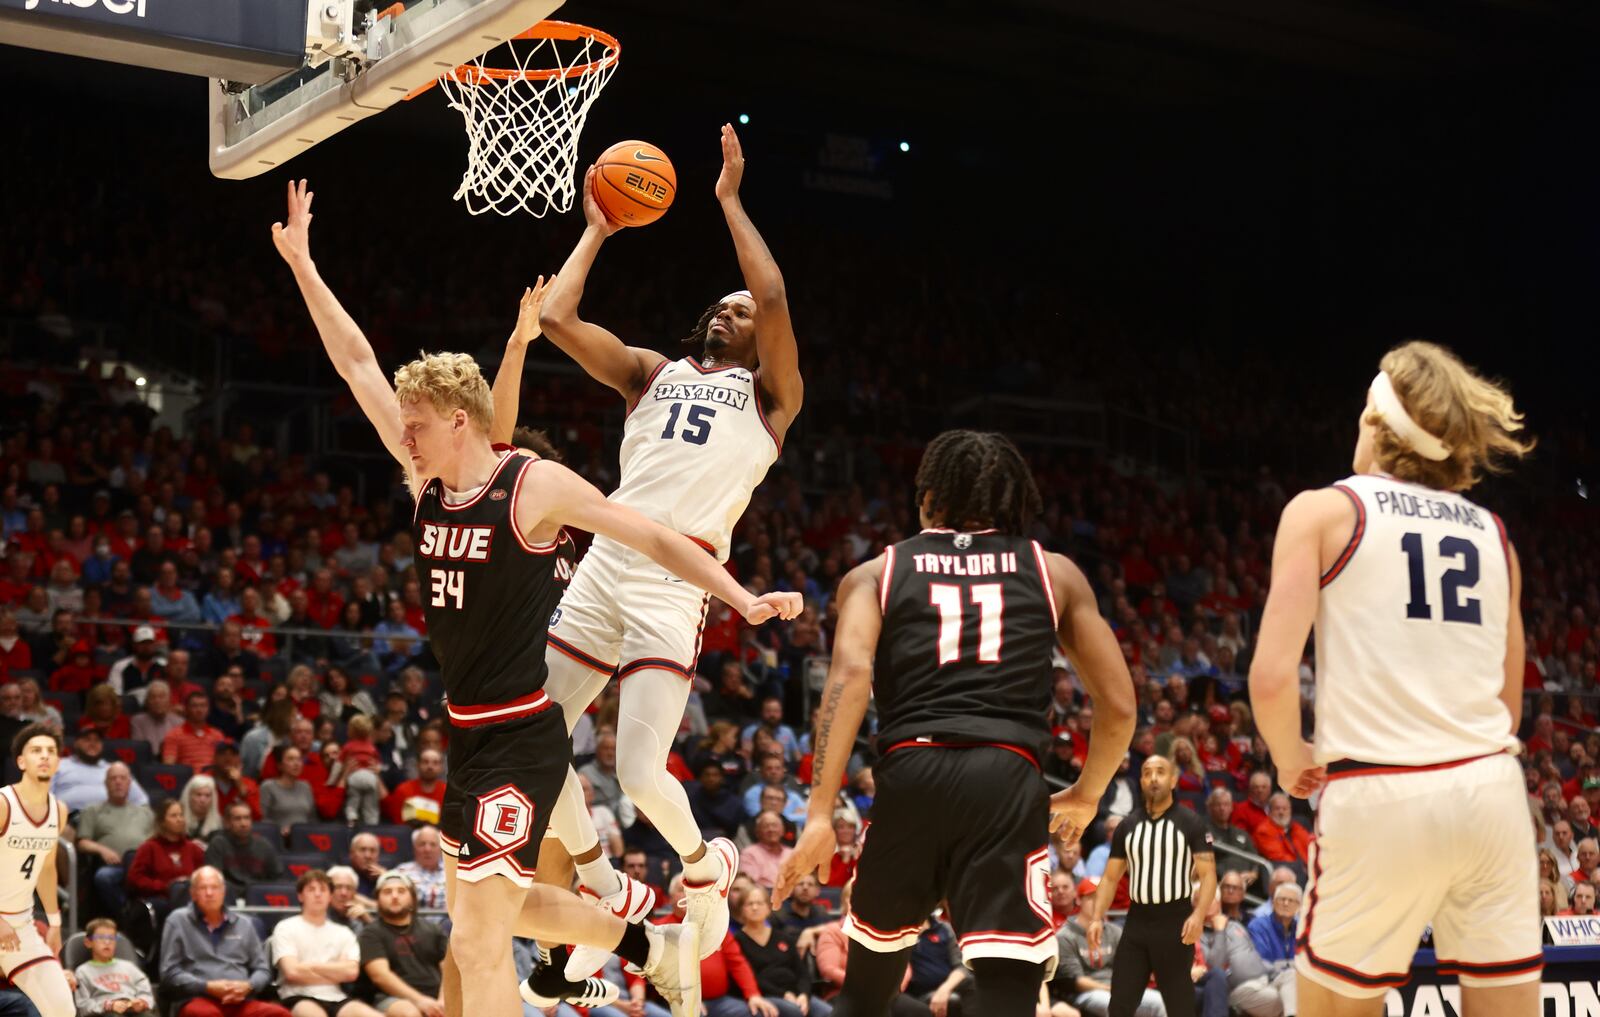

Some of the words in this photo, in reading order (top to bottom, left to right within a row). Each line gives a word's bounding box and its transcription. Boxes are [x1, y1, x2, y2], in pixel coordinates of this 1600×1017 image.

[625, 172, 667, 200] ELITE
[654, 383, 749, 411] DAYTON
[661, 402, 717, 446] 15
[1374, 490, 1485, 531] PADEGIMAS
[419, 521, 495, 562] SIUE
[913, 553, 996, 576] TAYLOR
[1001, 552, 1017, 573] II
[1400, 532, 1482, 626] 12
[430, 568, 465, 610] 34
[929, 582, 1004, 667] 11
[493, 803, 521, 836] E
[8, 835, 57, 851] DAYTO
[20, 854, 37, 880] 4
